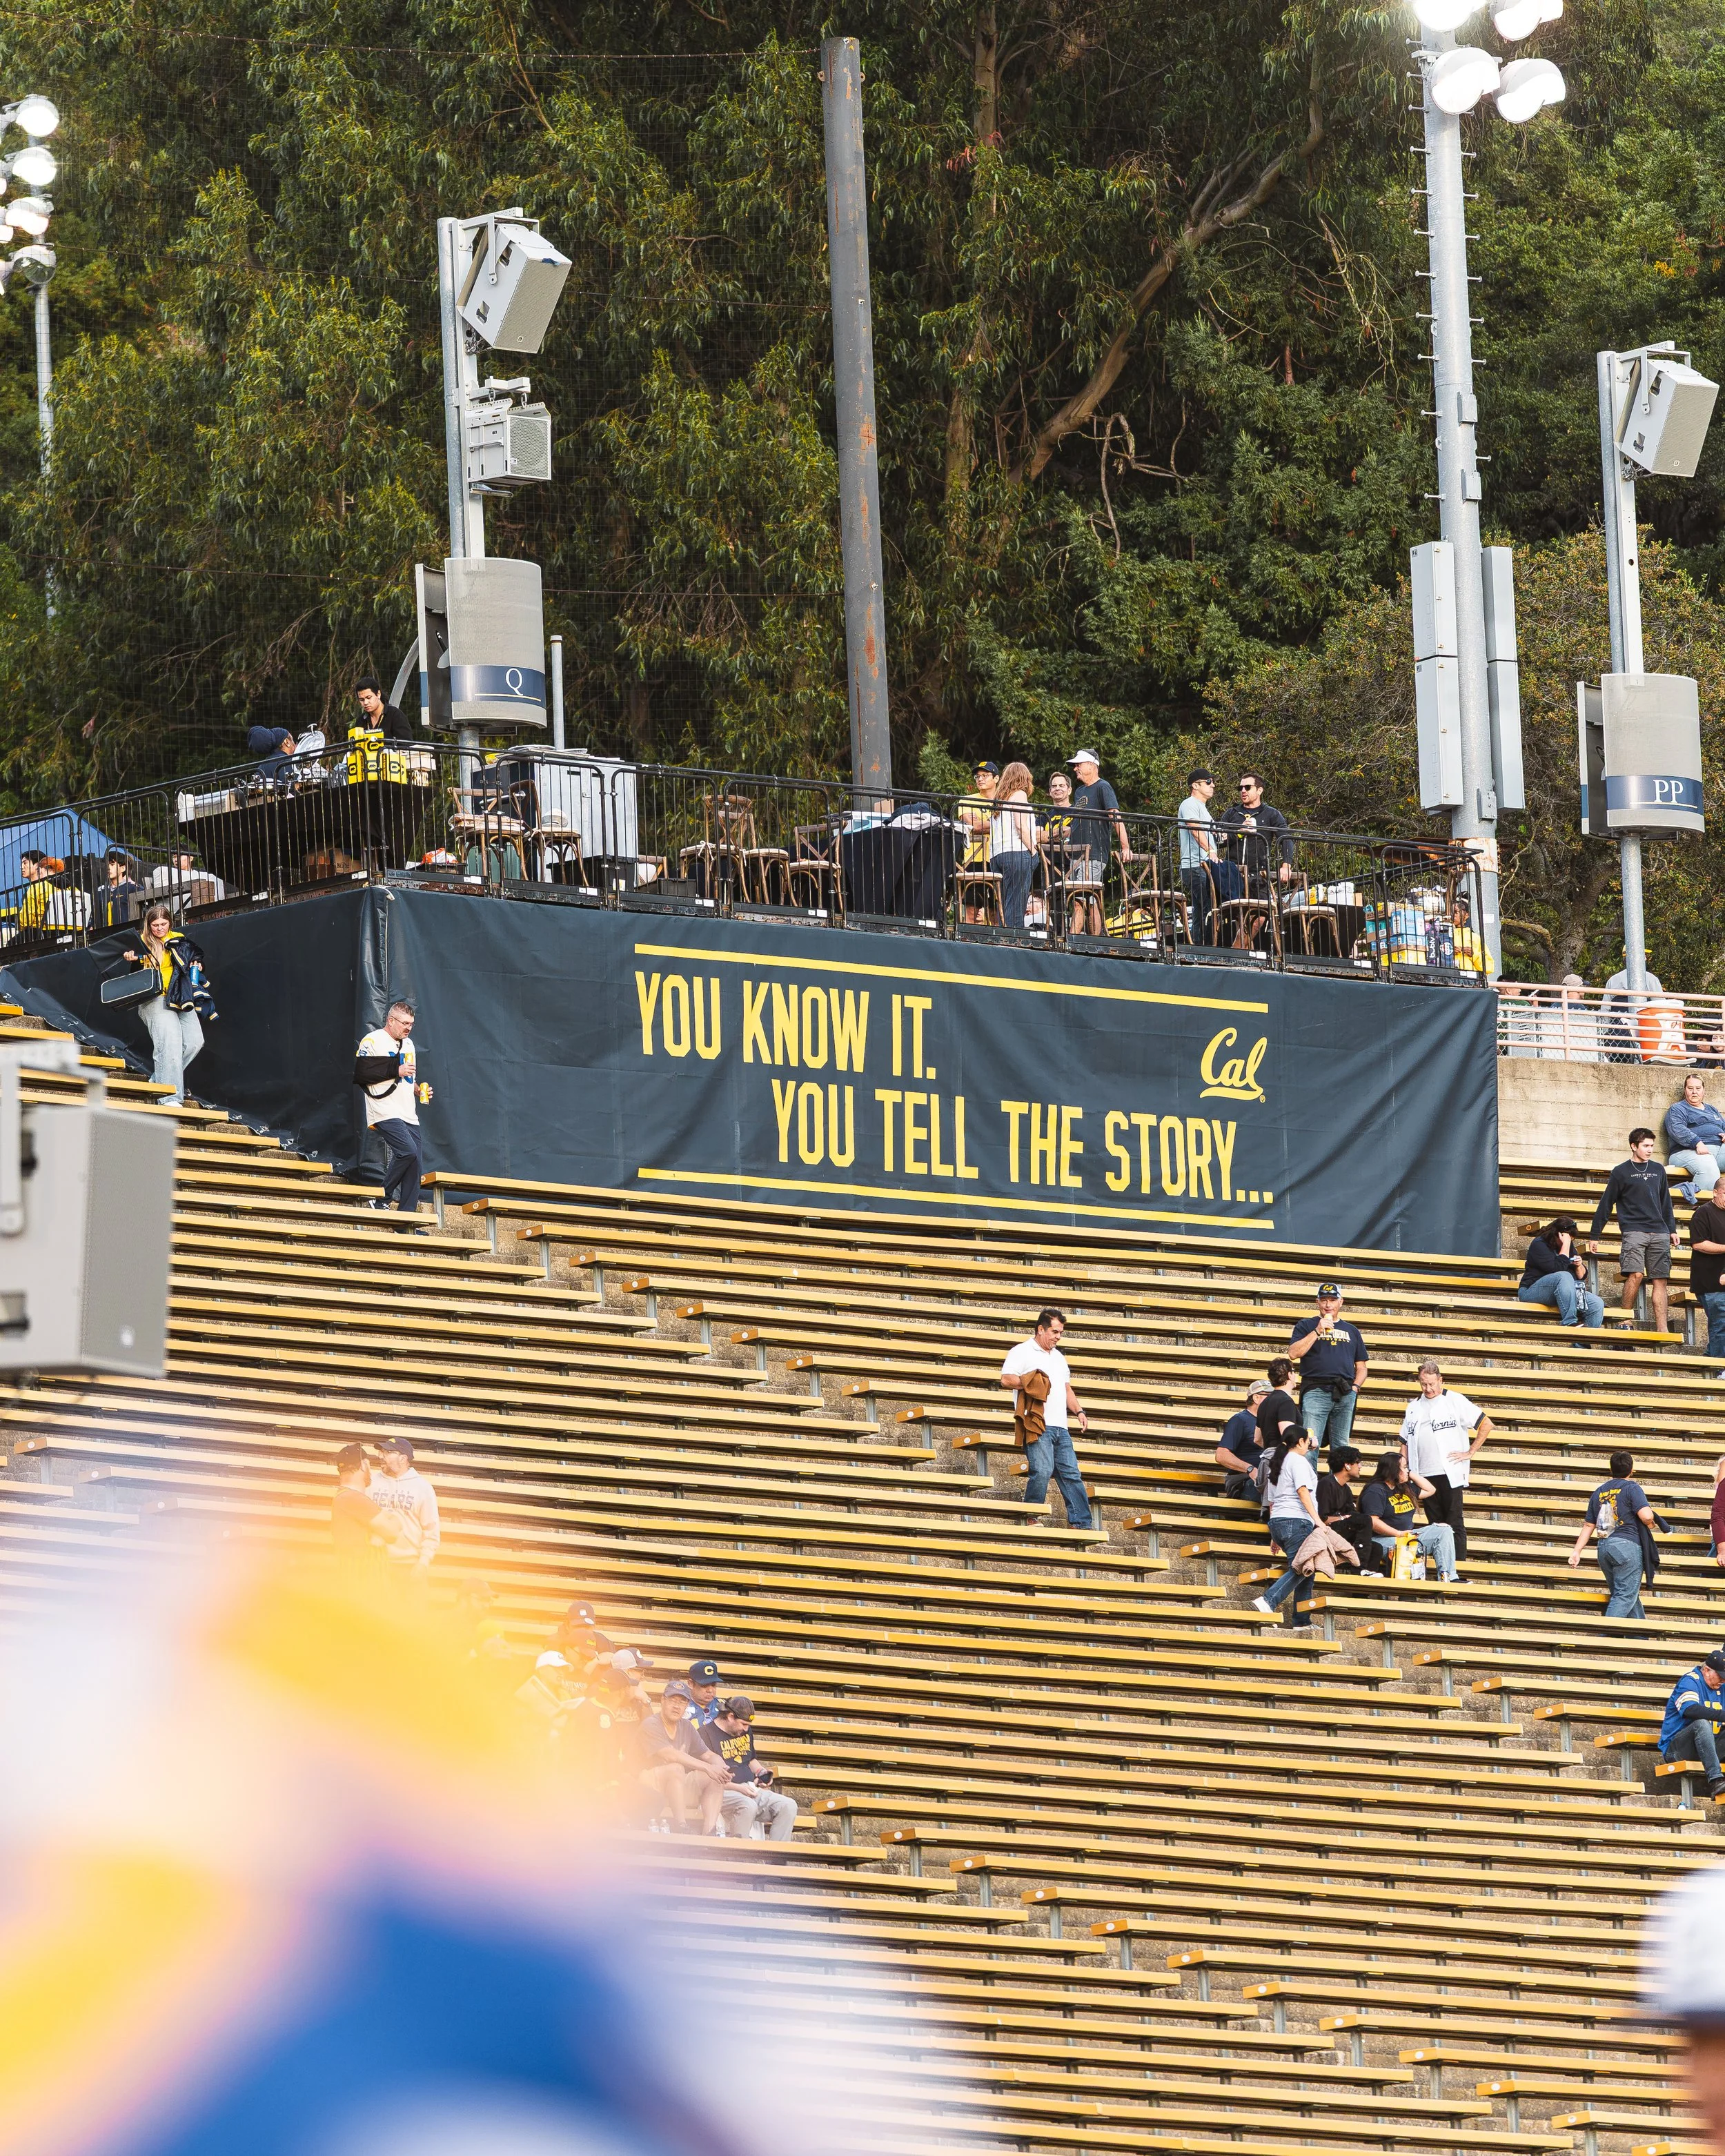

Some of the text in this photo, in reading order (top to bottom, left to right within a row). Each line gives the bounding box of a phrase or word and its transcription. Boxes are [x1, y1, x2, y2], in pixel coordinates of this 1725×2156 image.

[506, 668, 523, 695] Q
[1653, 780, 1684, 803] PP
[635, 971, 936, 1079] YOU KNOW IT.
[1200, 1027, 1268, 1100] Cal
[772, 1079, 1273, 1203] YOU TELL THE STORY...
[704, 1665, 715, 1676] C
